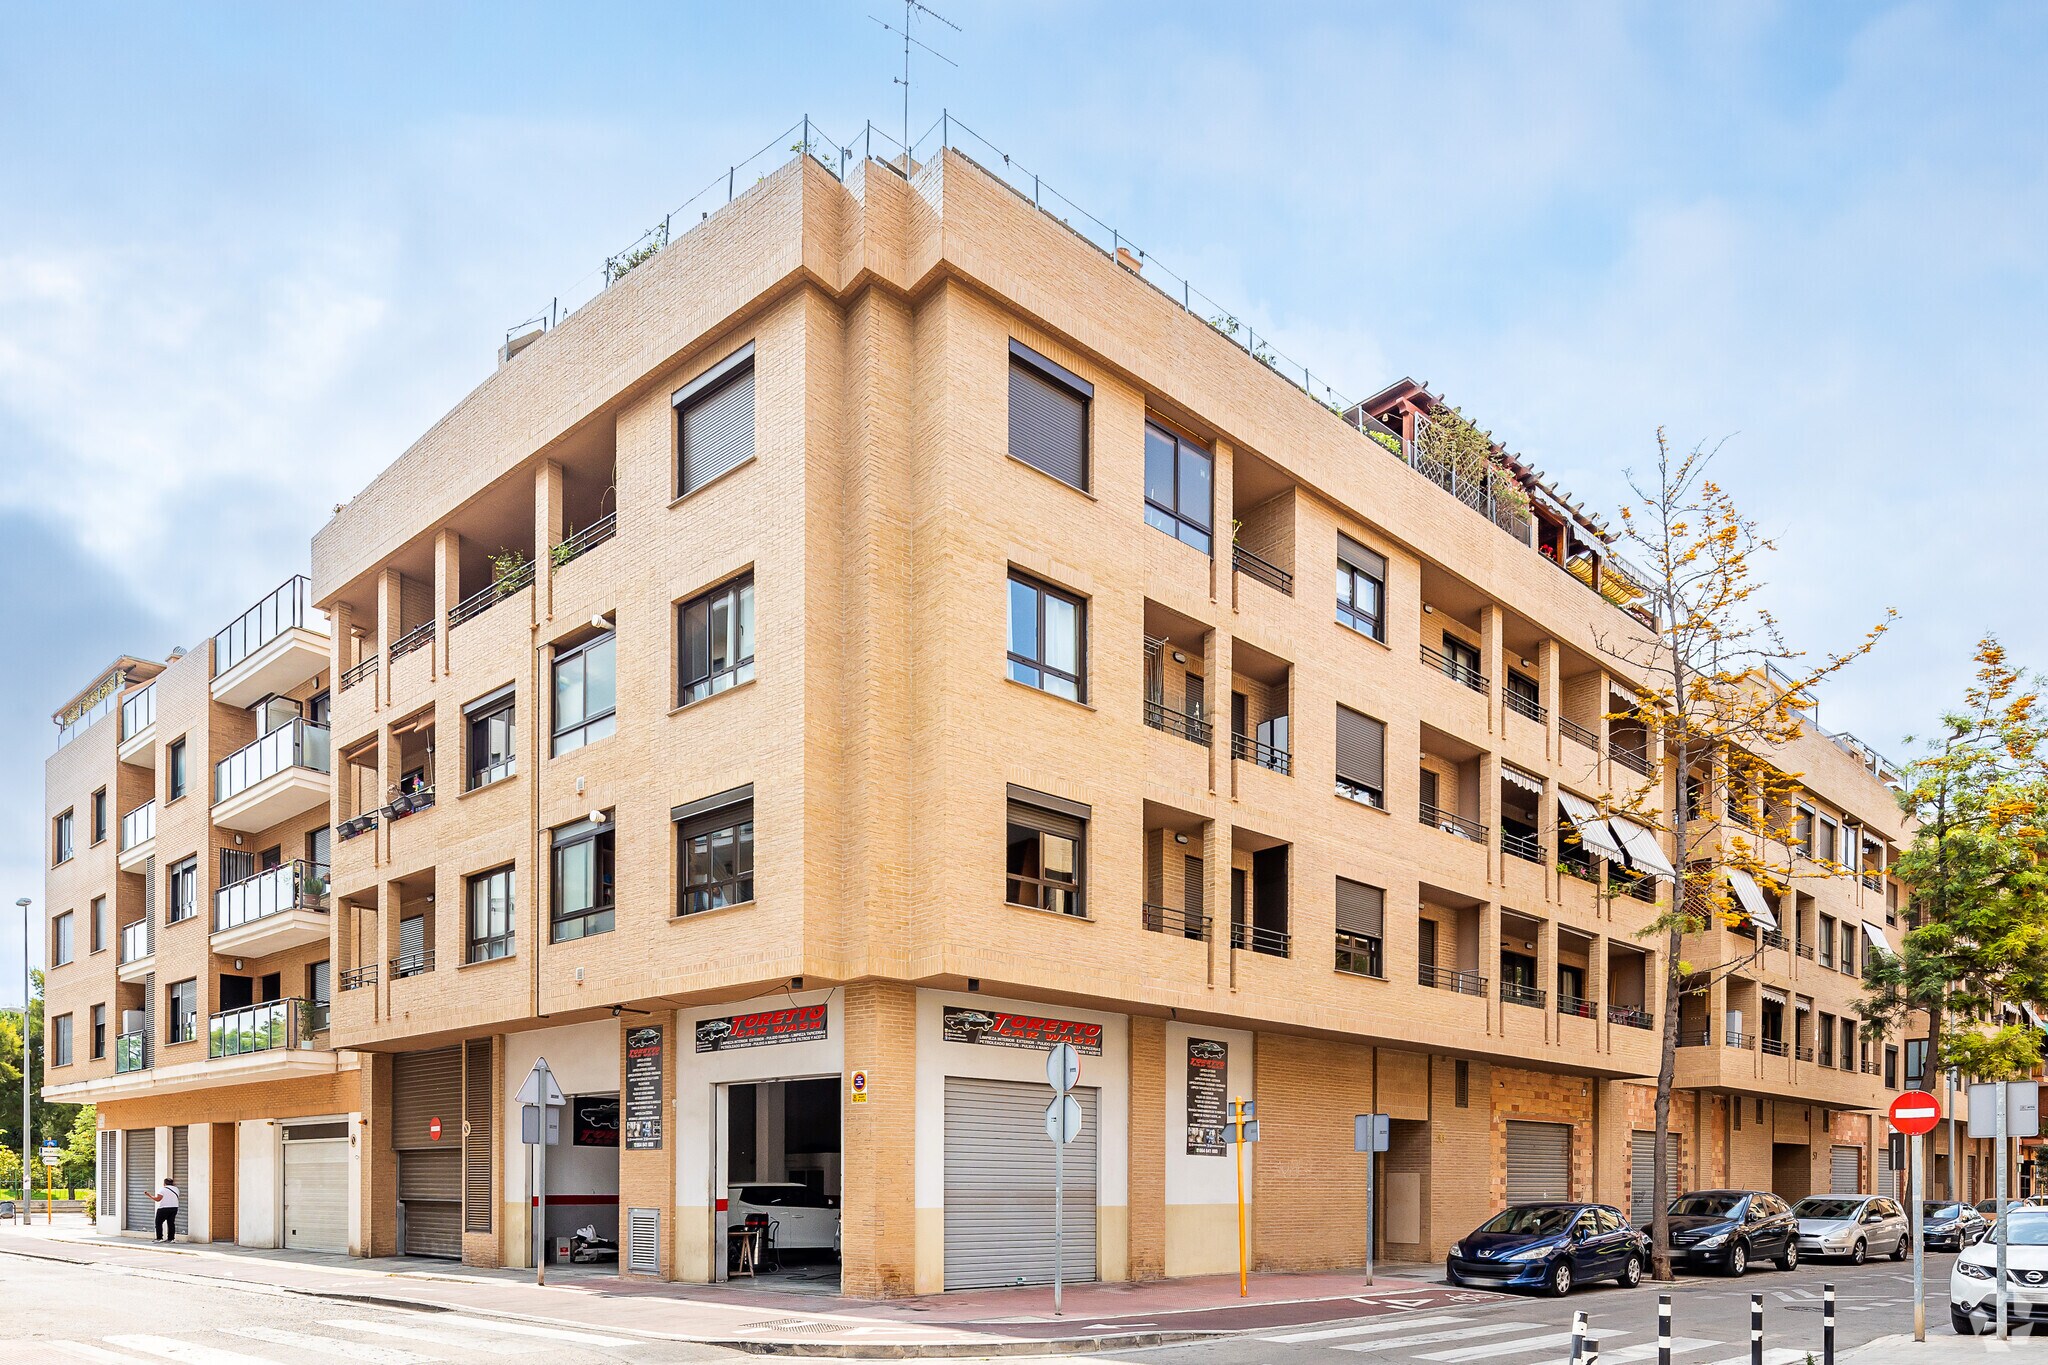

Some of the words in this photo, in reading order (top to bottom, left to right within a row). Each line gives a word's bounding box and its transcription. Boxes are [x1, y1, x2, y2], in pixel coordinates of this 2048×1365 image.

[730, 1005, 825, 1036] TORETTO
[737, 1027, 768, 1038] CAR
[774, 1021, 822, 1034] WASH
[992, 1013, 1101, 1037] TORETTO
[1000, 1028, 1039, 1039] CAR
[1045, 1033, 1097, 1046] WASH
